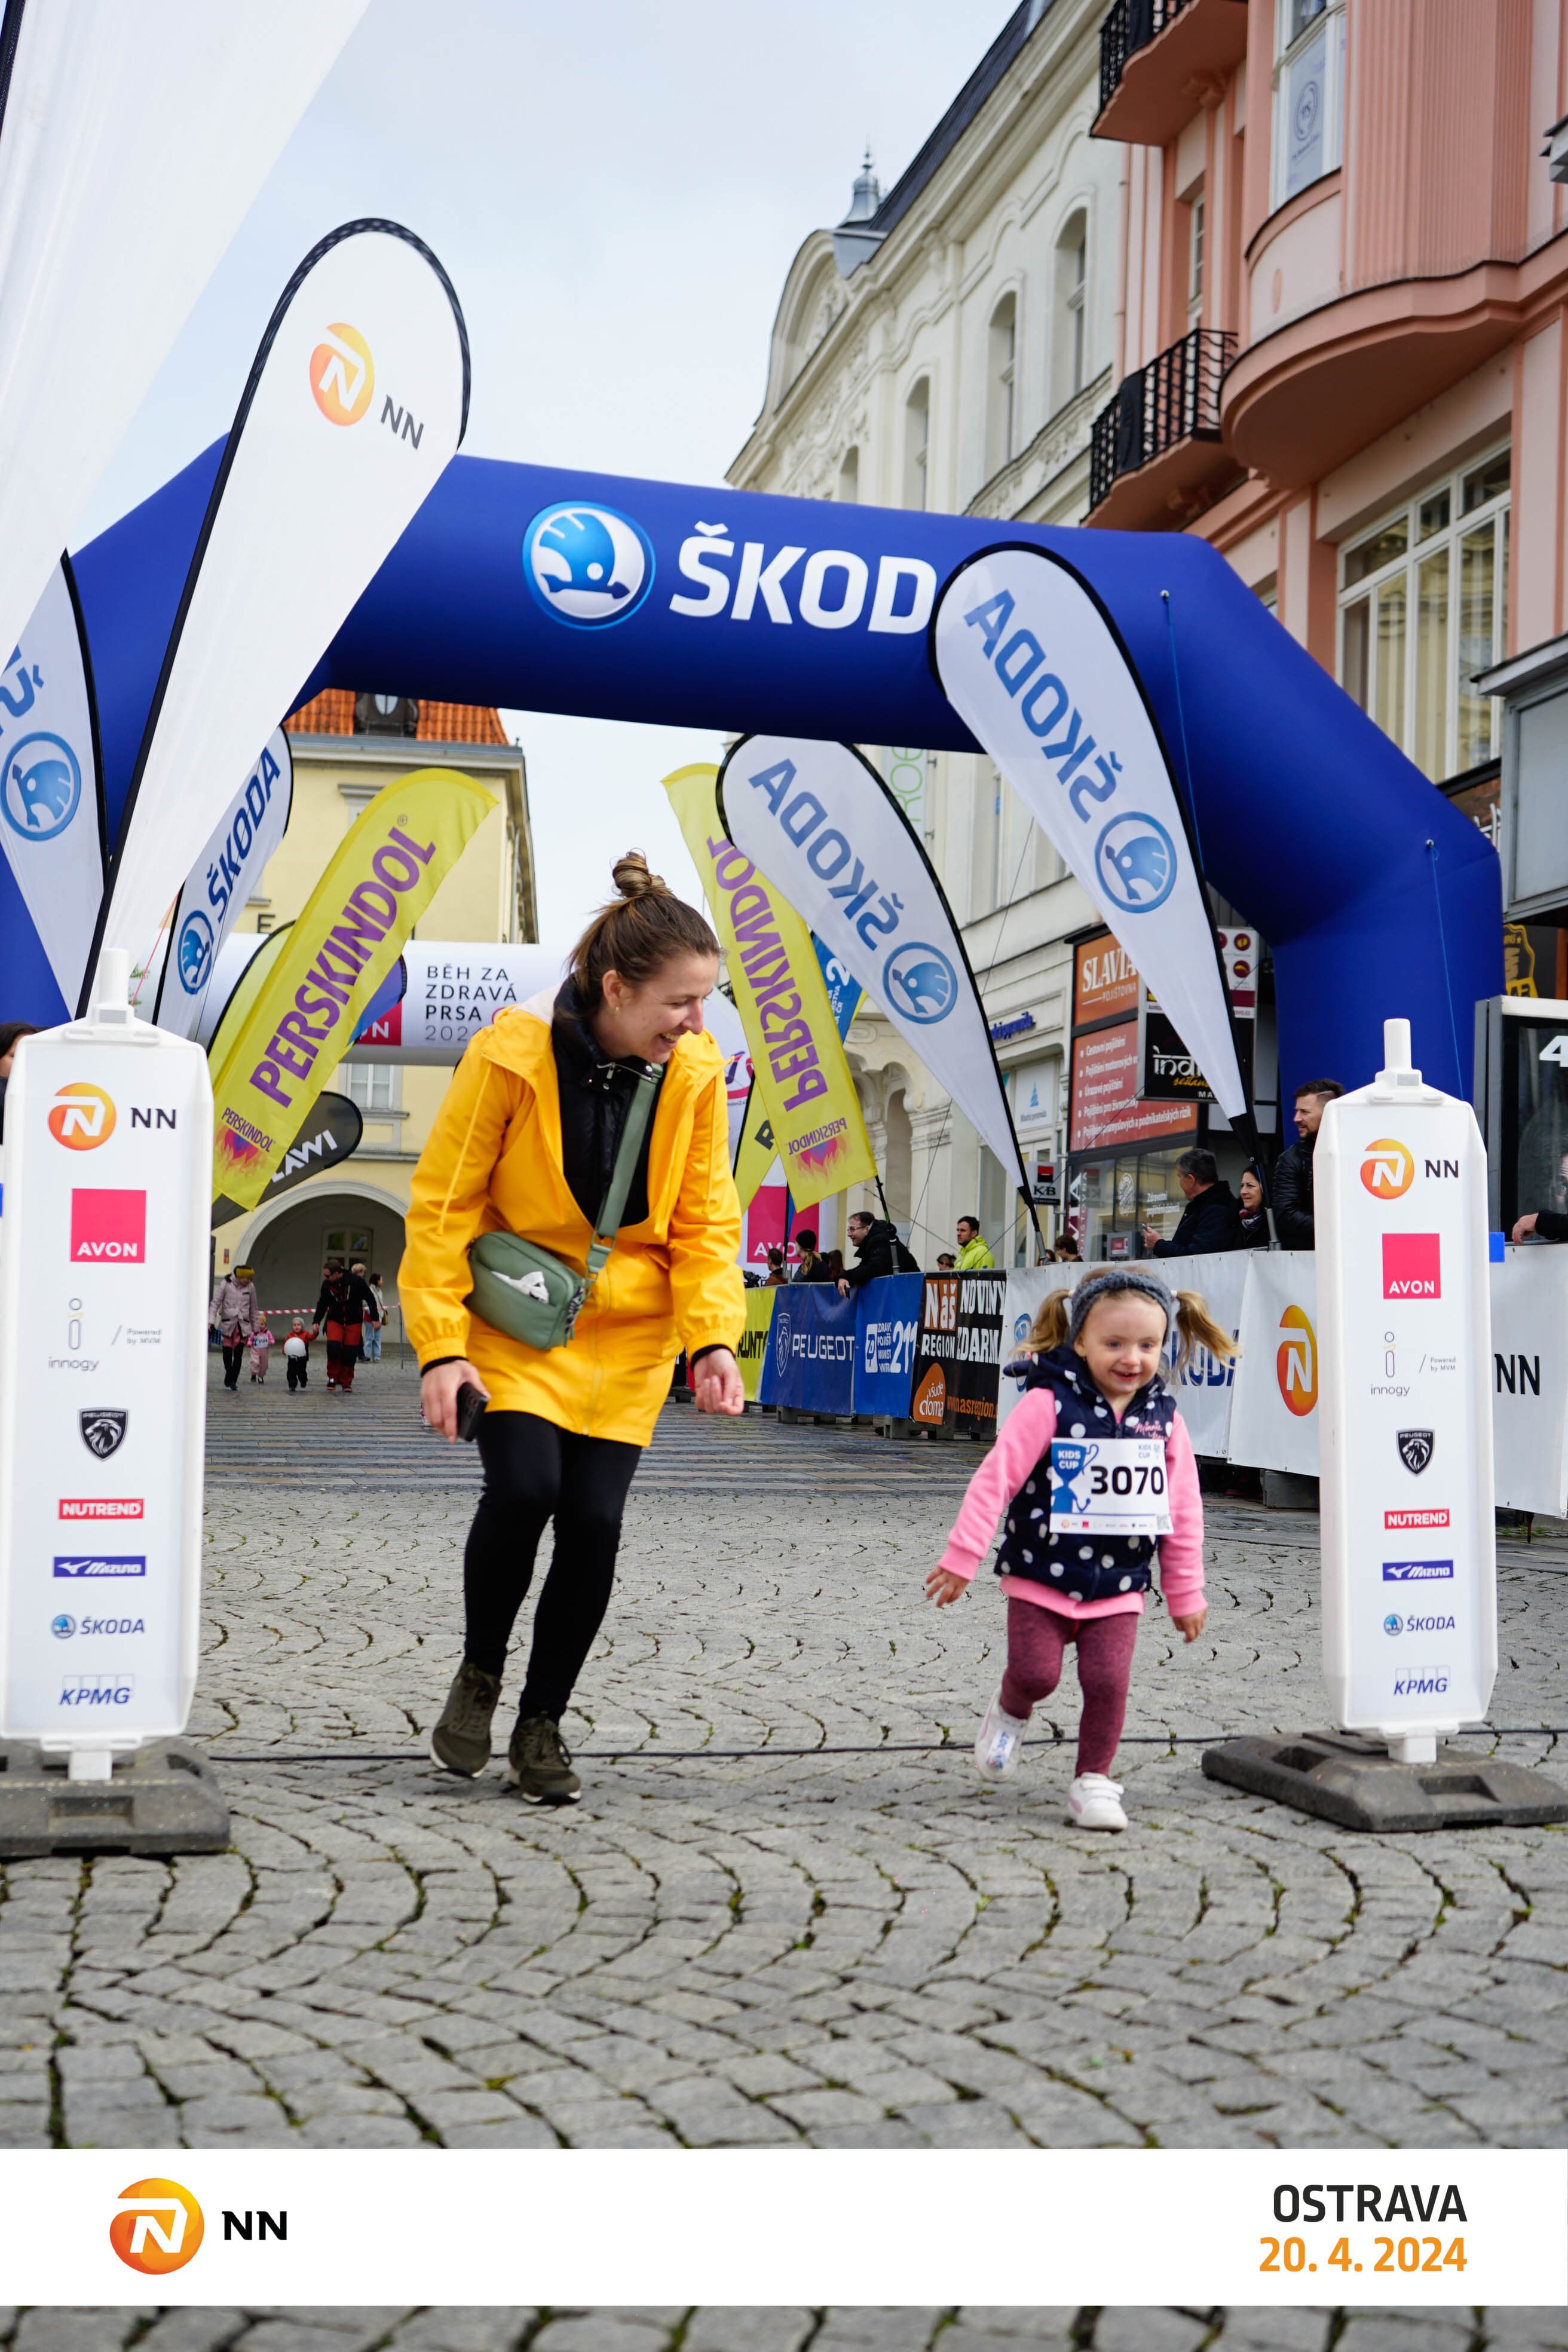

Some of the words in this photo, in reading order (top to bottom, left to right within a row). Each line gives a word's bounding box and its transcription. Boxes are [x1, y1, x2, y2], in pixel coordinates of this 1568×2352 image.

[380, 393, 425, 450] NN
[669, 520, 938, 635] ŠKOD
[206, 746, 281, 923] ŠKODA
[249, 825, 436, 1109] PERSKINDOL
[427, 963, 470, 980] BĚH
[481, 967, 509, 981] ZA
[1082, 947, 1137, 993] SLAVIA
[425, 983, 517, 1002] ZDRAVÁ
[425, 1004, 482, 1021] PRSA
[425, 1024, 482, 1042] 202
[130, 1107, 176, 1129] NN
[221, 1107, 274, 1153] PERSKINDOL
[1425, 1160, 1459, 1178] NN
[1034, 1185, 1056, 1195] KB
[76, 1242, 138, 1258] AVON
[754, 1242, 797, 1257] AVO
[1388, 1280, 1435, 1294] AVON
[924, 1283, 956, 1330] Náš
[792, 1334, 855, 1362] PEUGEOT
[890, 1320, 918, 1374] 211
[921, 1334, 956, 1359] REGION
[956, 1327, 1000, 1365] ZDARM
[48, 1357, 100, 1371] innogy
[1494, 1353, 1540, 1396] NN
[1370, 1385, 1410, 1396] innogy
[919, 1395, 944, 1417] doma
[1057, 1450, 1081, 1460] KIDS
[1058, 1460, 1079, 1470] CUP
[1091, 1465, 1165, 1495] 3070
[62, 1502, 142, 1517] NUTREND
[1387, 1510, 1448, 1527] NUTREND
[79, 1616, 145, 1635] ŠKODA
[1406, 1615, 1456, 1632] ŠKODA
[59, 1686, 131, 1706] KPMG
[1393, 1677, 1448, 1696] KPMG
